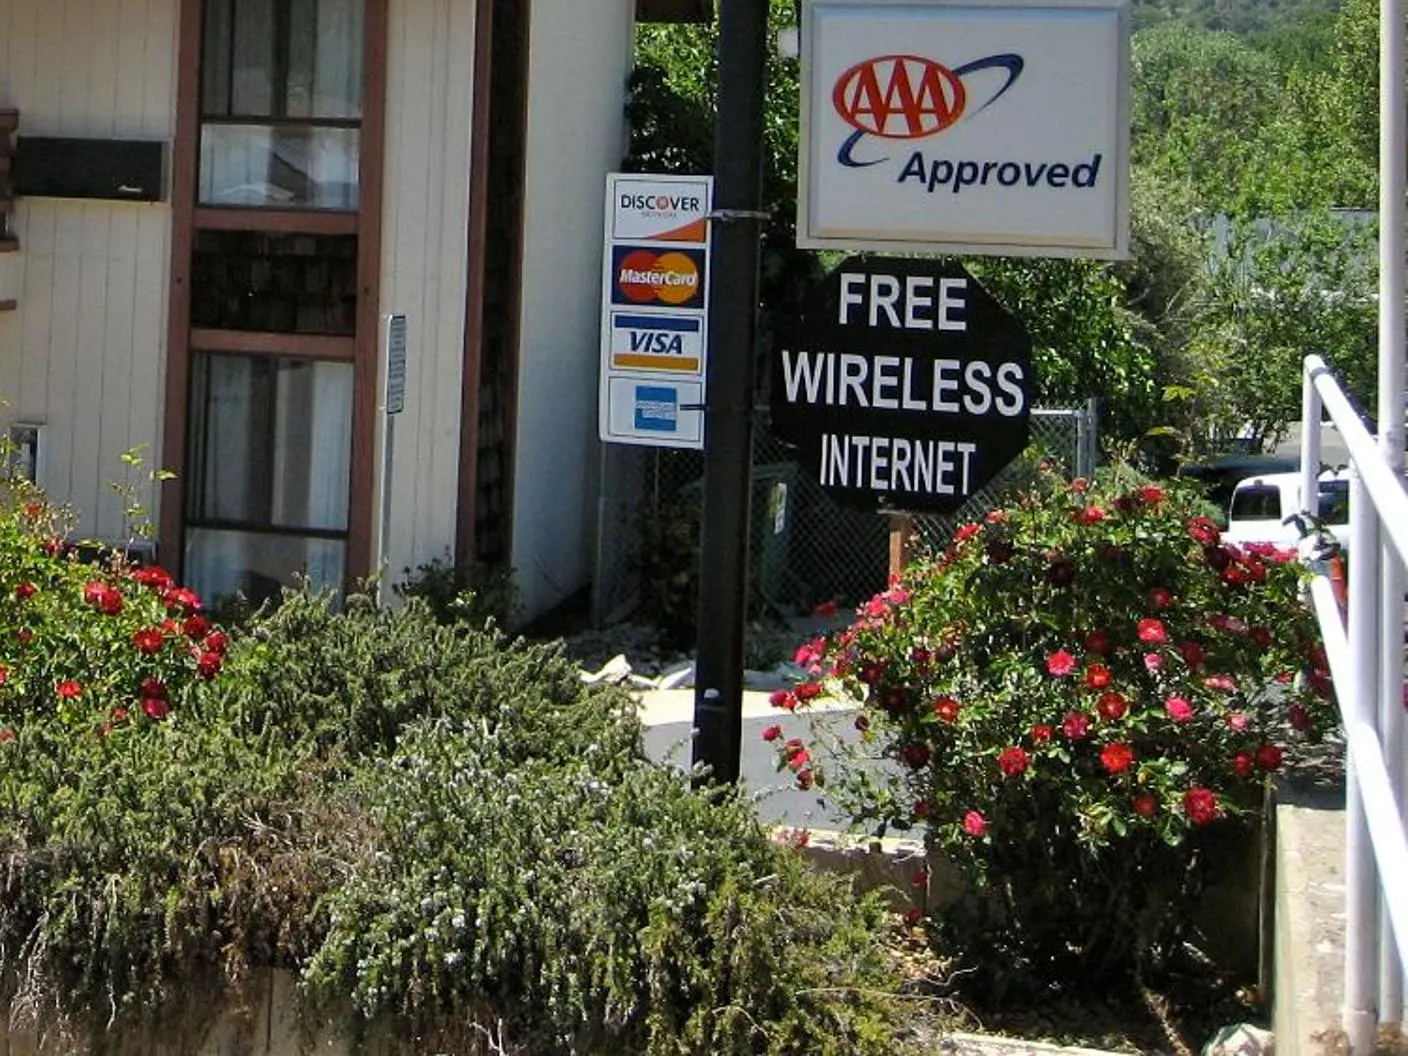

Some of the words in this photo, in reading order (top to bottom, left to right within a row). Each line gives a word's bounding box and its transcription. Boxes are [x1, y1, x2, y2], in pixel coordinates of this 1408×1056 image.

[848, 56, 956, 136] AAA
[898, 151, 1101, 193] Approved
[621, 194, 700, 211] DISCOVER
[620, 268, 698, 286] MasterCard
[839, 273, 968, 331] FREE
[629, 331, 684, 355] VISA
[781, 349, 1024, 417] WIRELESS
[820, 434, 977, 495] INTERNET
